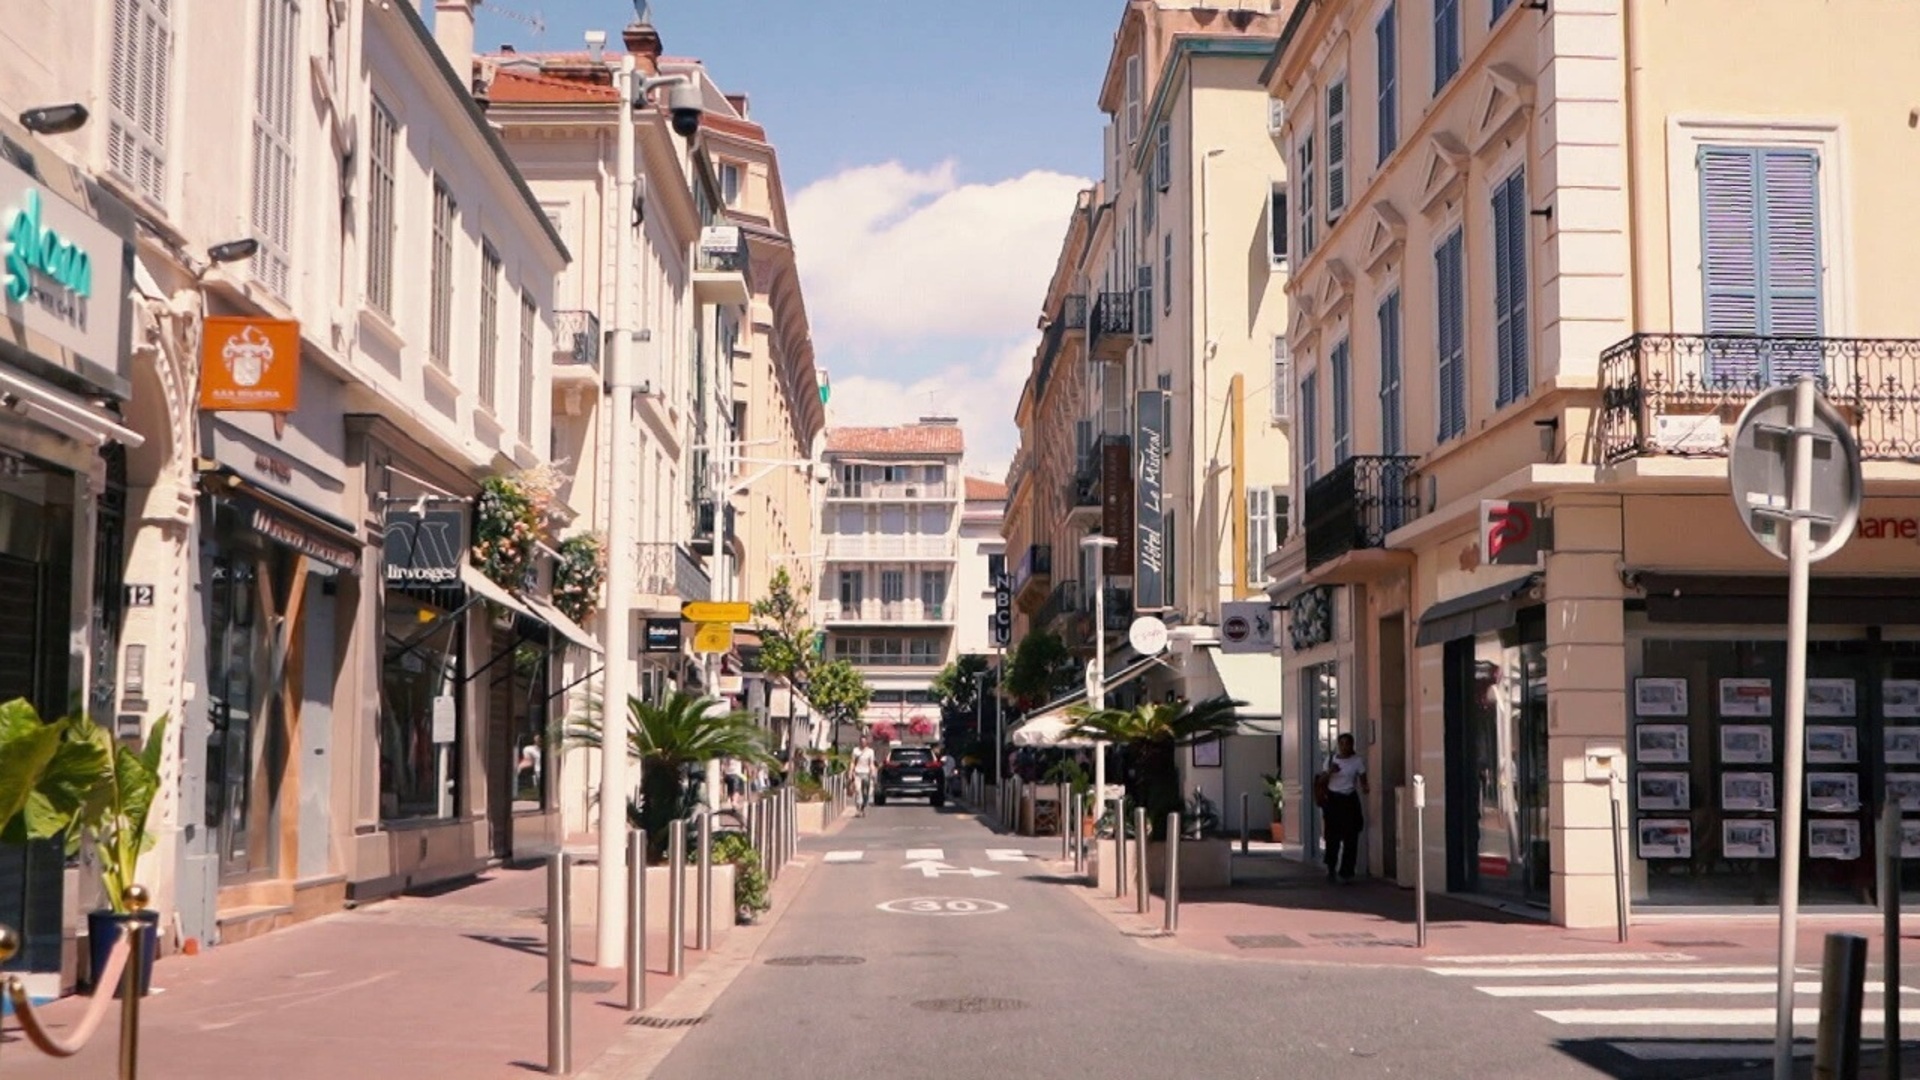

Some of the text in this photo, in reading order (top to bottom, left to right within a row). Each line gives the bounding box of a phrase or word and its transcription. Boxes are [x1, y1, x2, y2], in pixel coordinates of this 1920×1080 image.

[1144, 490, 1160, 513] Le
[130, 586, 151, 604] 12
[911, 900, 979, 912] 30
